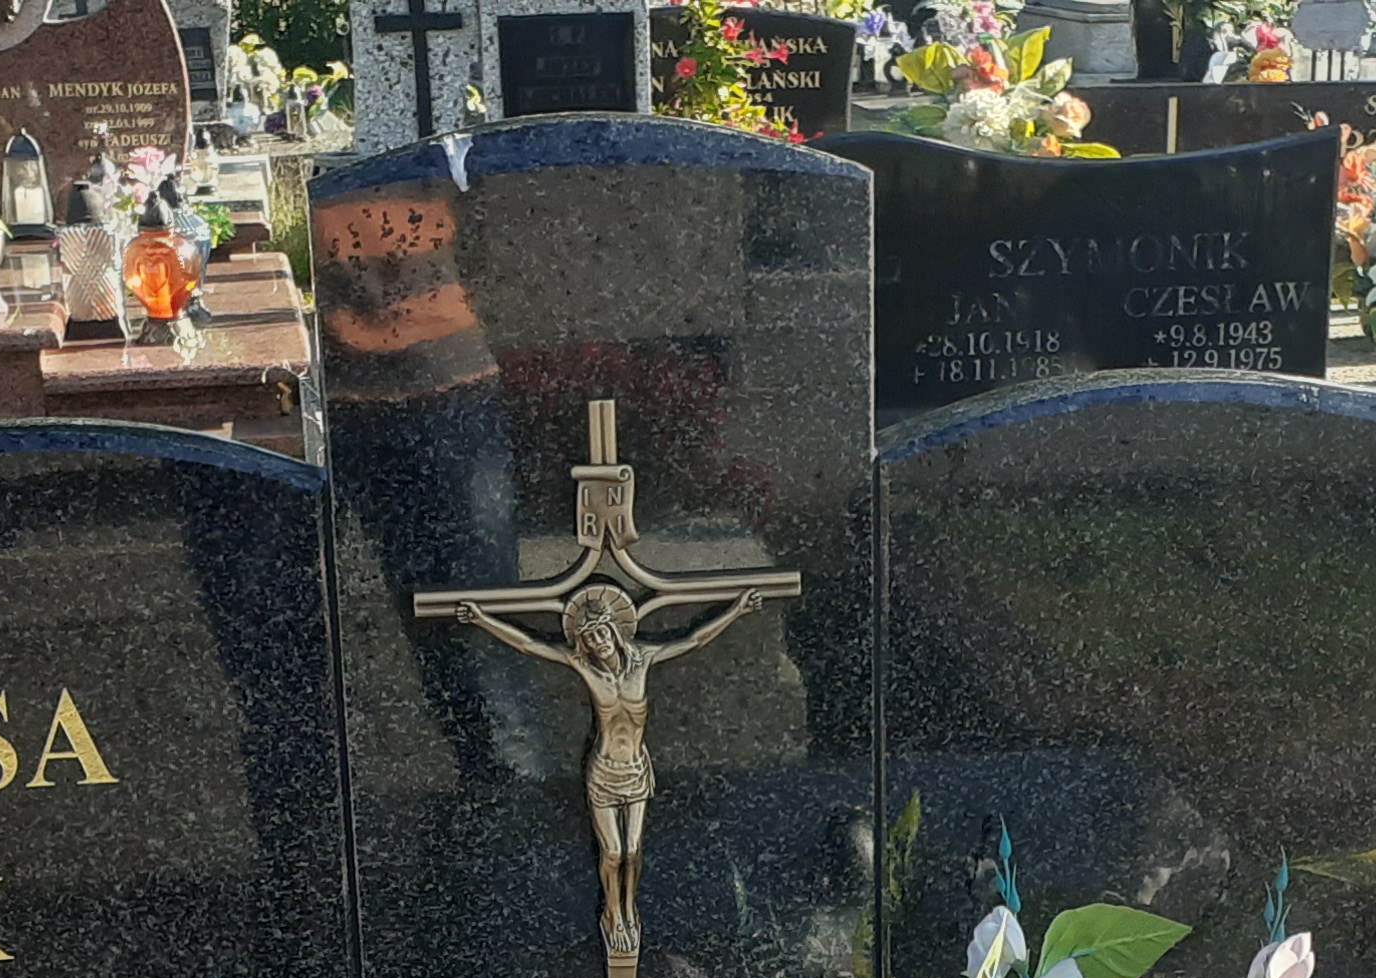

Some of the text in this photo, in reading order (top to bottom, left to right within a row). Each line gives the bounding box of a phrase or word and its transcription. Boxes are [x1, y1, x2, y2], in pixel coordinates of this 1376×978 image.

[48, 80, 178, 98] MENDYK JÓZEFA
[988, 231, 1251, 279] SZYMONIK
[1123, 281, 1311, 319] CZESŁAW
